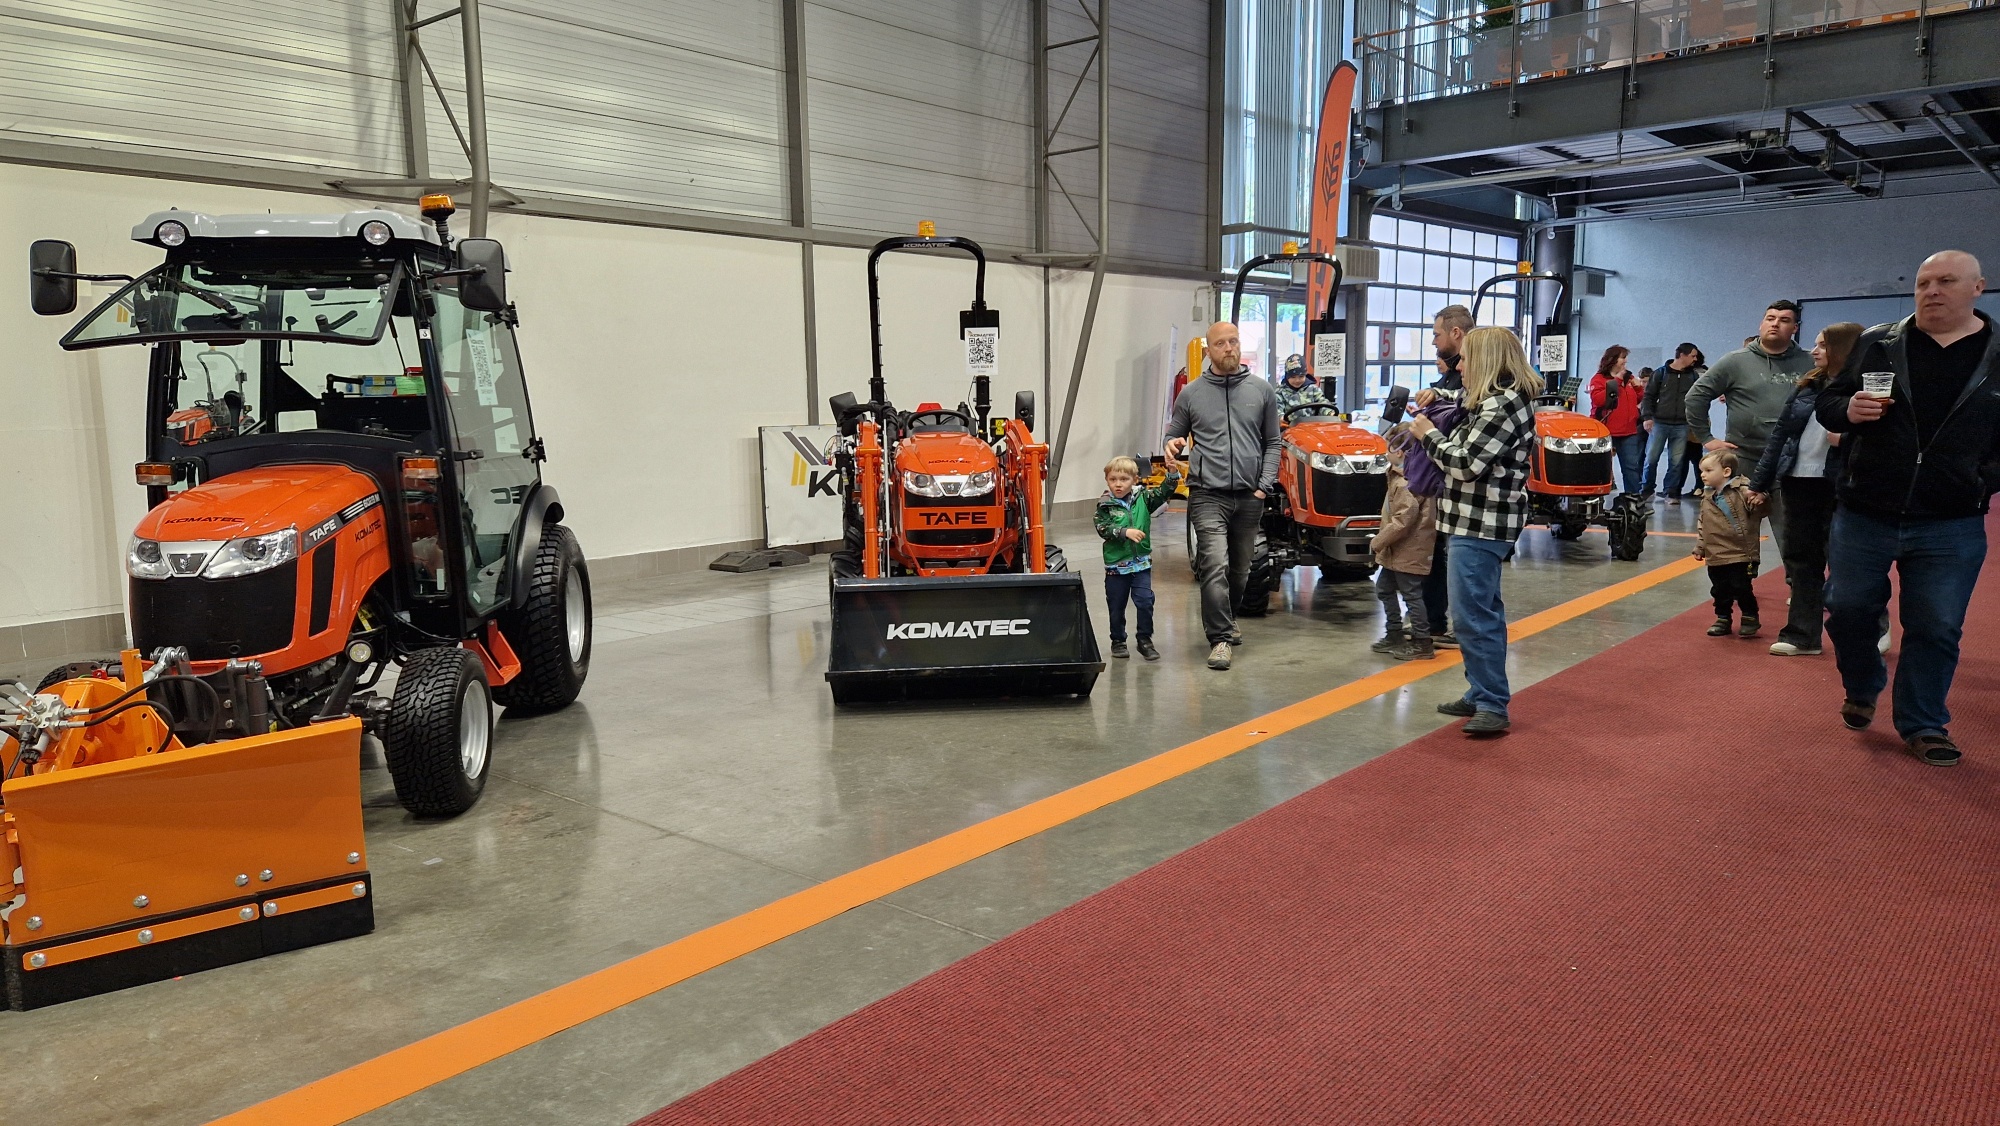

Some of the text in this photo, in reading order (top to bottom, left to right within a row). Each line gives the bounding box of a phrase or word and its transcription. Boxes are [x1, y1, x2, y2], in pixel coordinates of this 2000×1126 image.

[1382, 329, 1391, 357] 5
[808, 470, 843, 498] K
[164, 516, 245, 525] KOMATEC
[919, 511, 987, 526] TAFE
[309, 519, 337, 542] TAFE
[354, 519, 381, 542] KOMATEC
[886, 619, 1031, 640] KOMATEC
